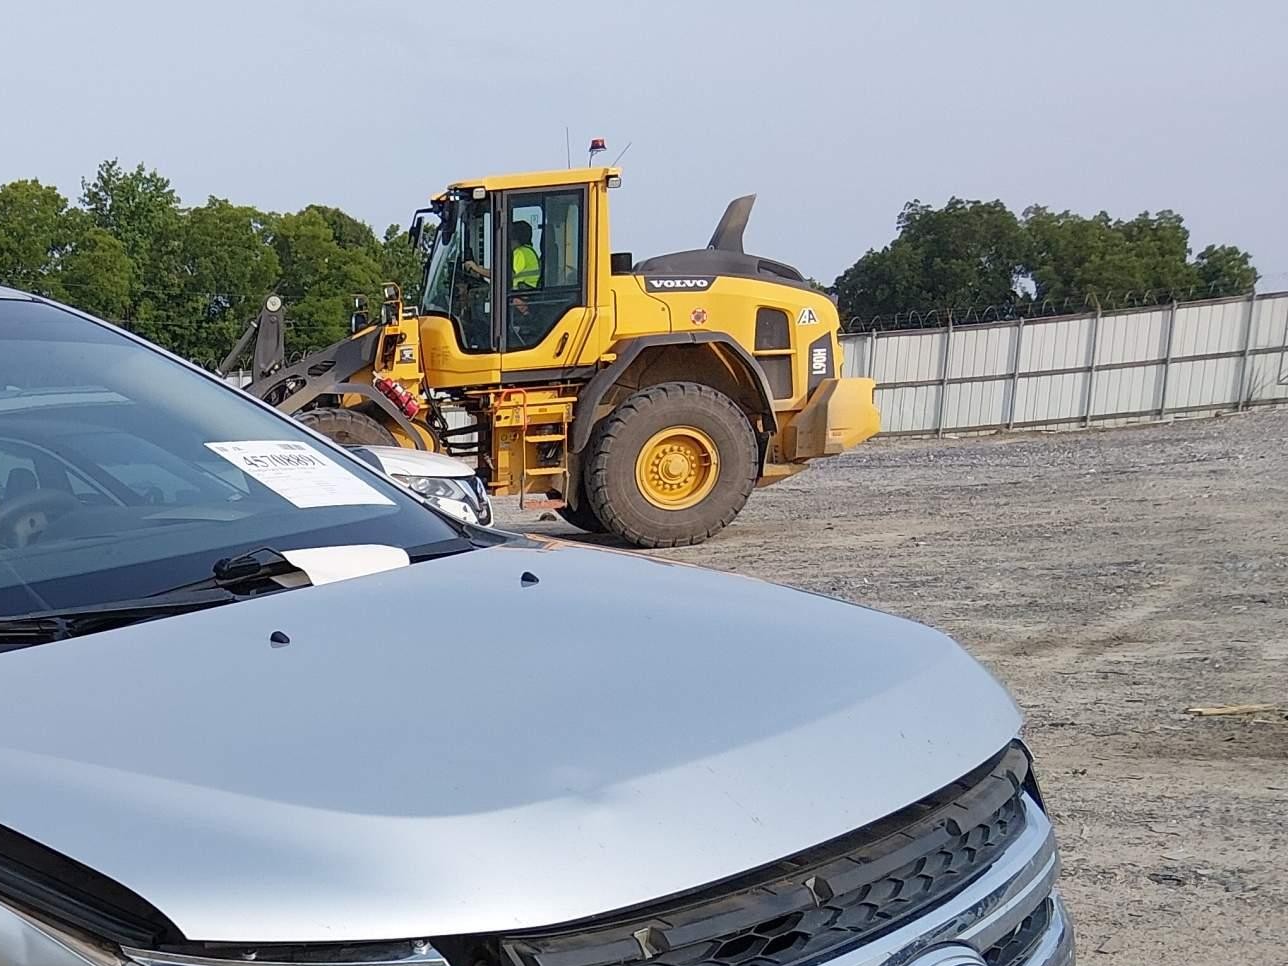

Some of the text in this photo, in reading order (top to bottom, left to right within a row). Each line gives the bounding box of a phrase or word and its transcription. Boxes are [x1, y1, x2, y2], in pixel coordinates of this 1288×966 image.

[649, 279, 709, 288] VOLVO
[812, 348, 827, 375] L90H
[242, 453, 327, 468] 45708891
